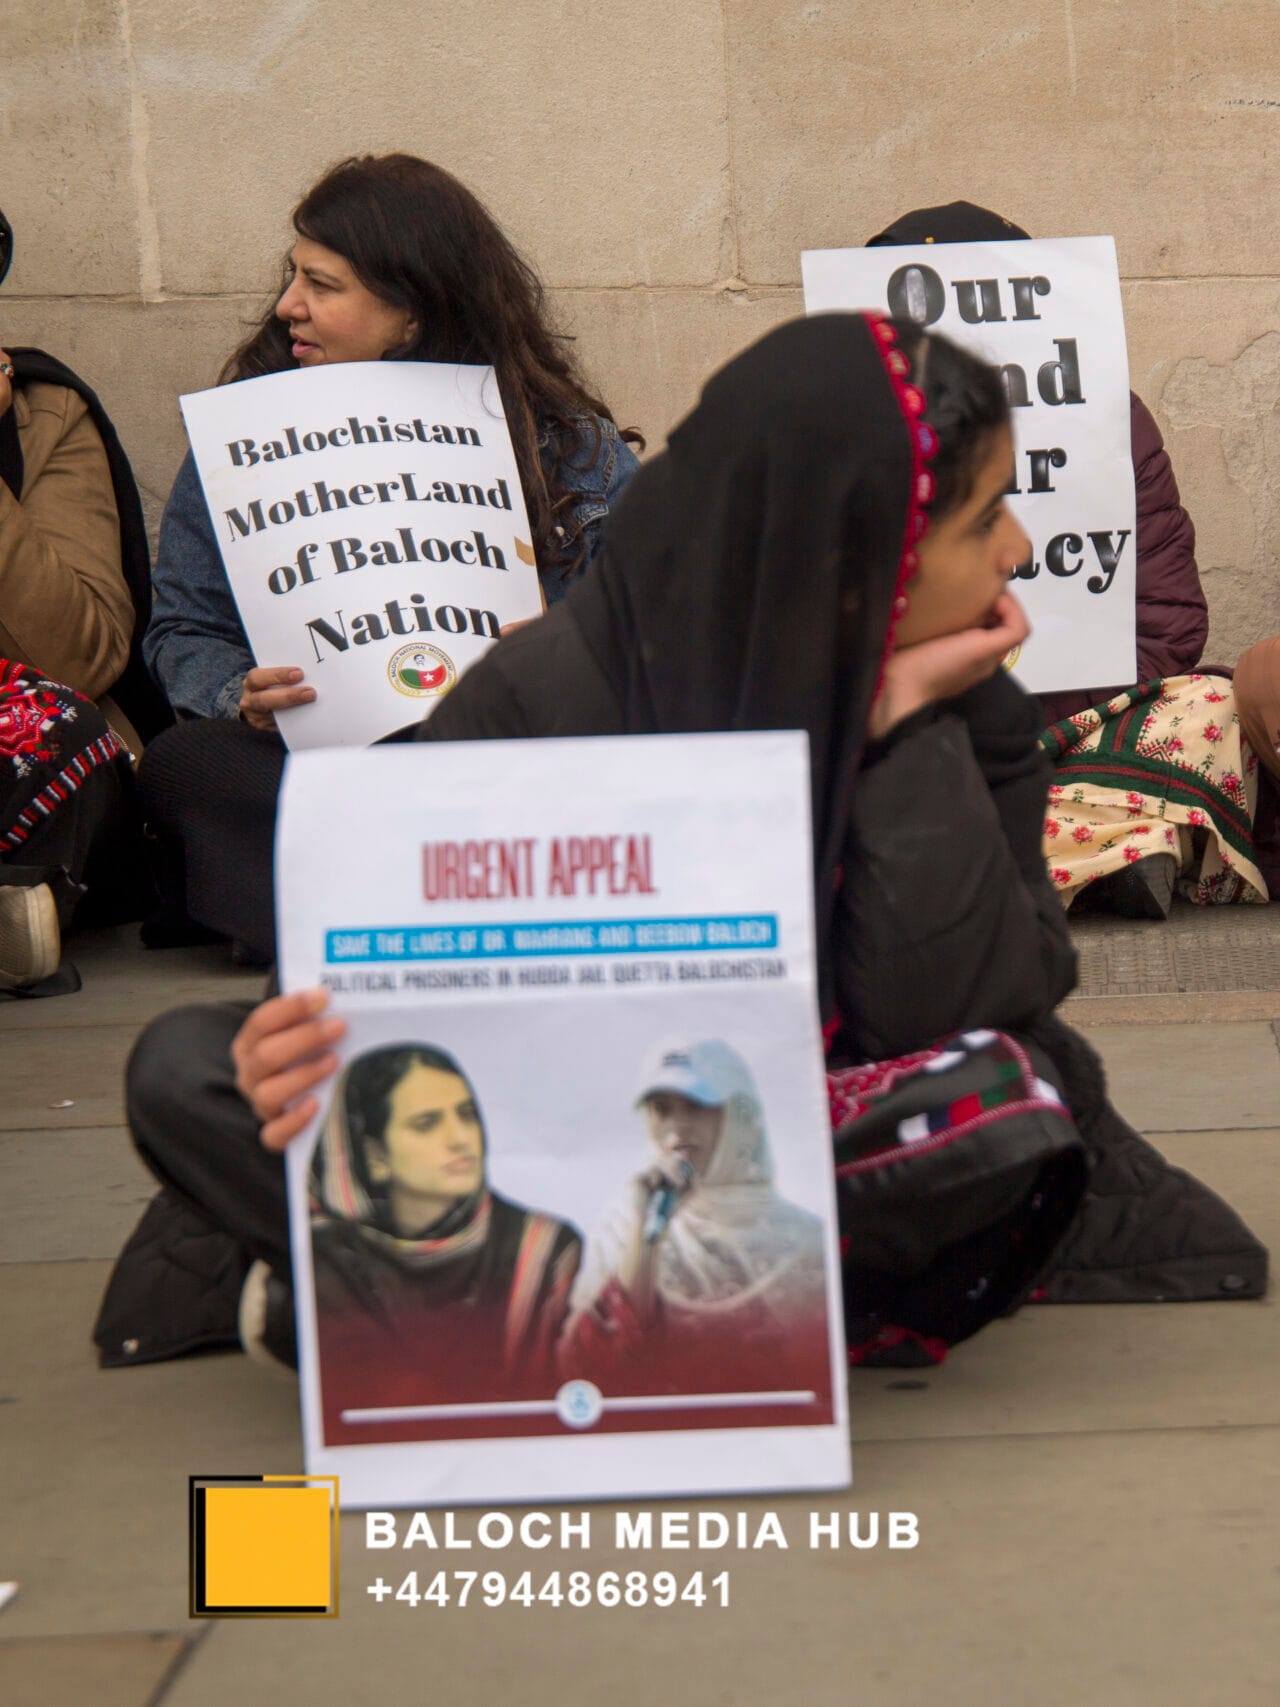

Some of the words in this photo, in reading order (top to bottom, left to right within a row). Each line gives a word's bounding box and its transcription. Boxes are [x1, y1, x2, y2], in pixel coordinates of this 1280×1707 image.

[887, 263, 1052, 328] Our
[225, 416, 483, 468] Balochistan
[224, 473, 513, 542] MotherLand
[268, 543, 322, 595] of
[327, 528, 509, 575] Baloch
[305, 593, 501, 664] Nation
[423, 839, 537, 901] URGENT
[548, 833, 658, 897] APPEAL
[333, 933, 370, 957] SAVE
[375, 932, 405, 955] THE
[458, 929, 478, 952] OF
[598, 924, 632, 947] AND
[706, 920, 773, 945] BALOCH
[403, 966, 491, 989] PRISONERS
[678, 958, 787, 980] BALOCHISTAN
